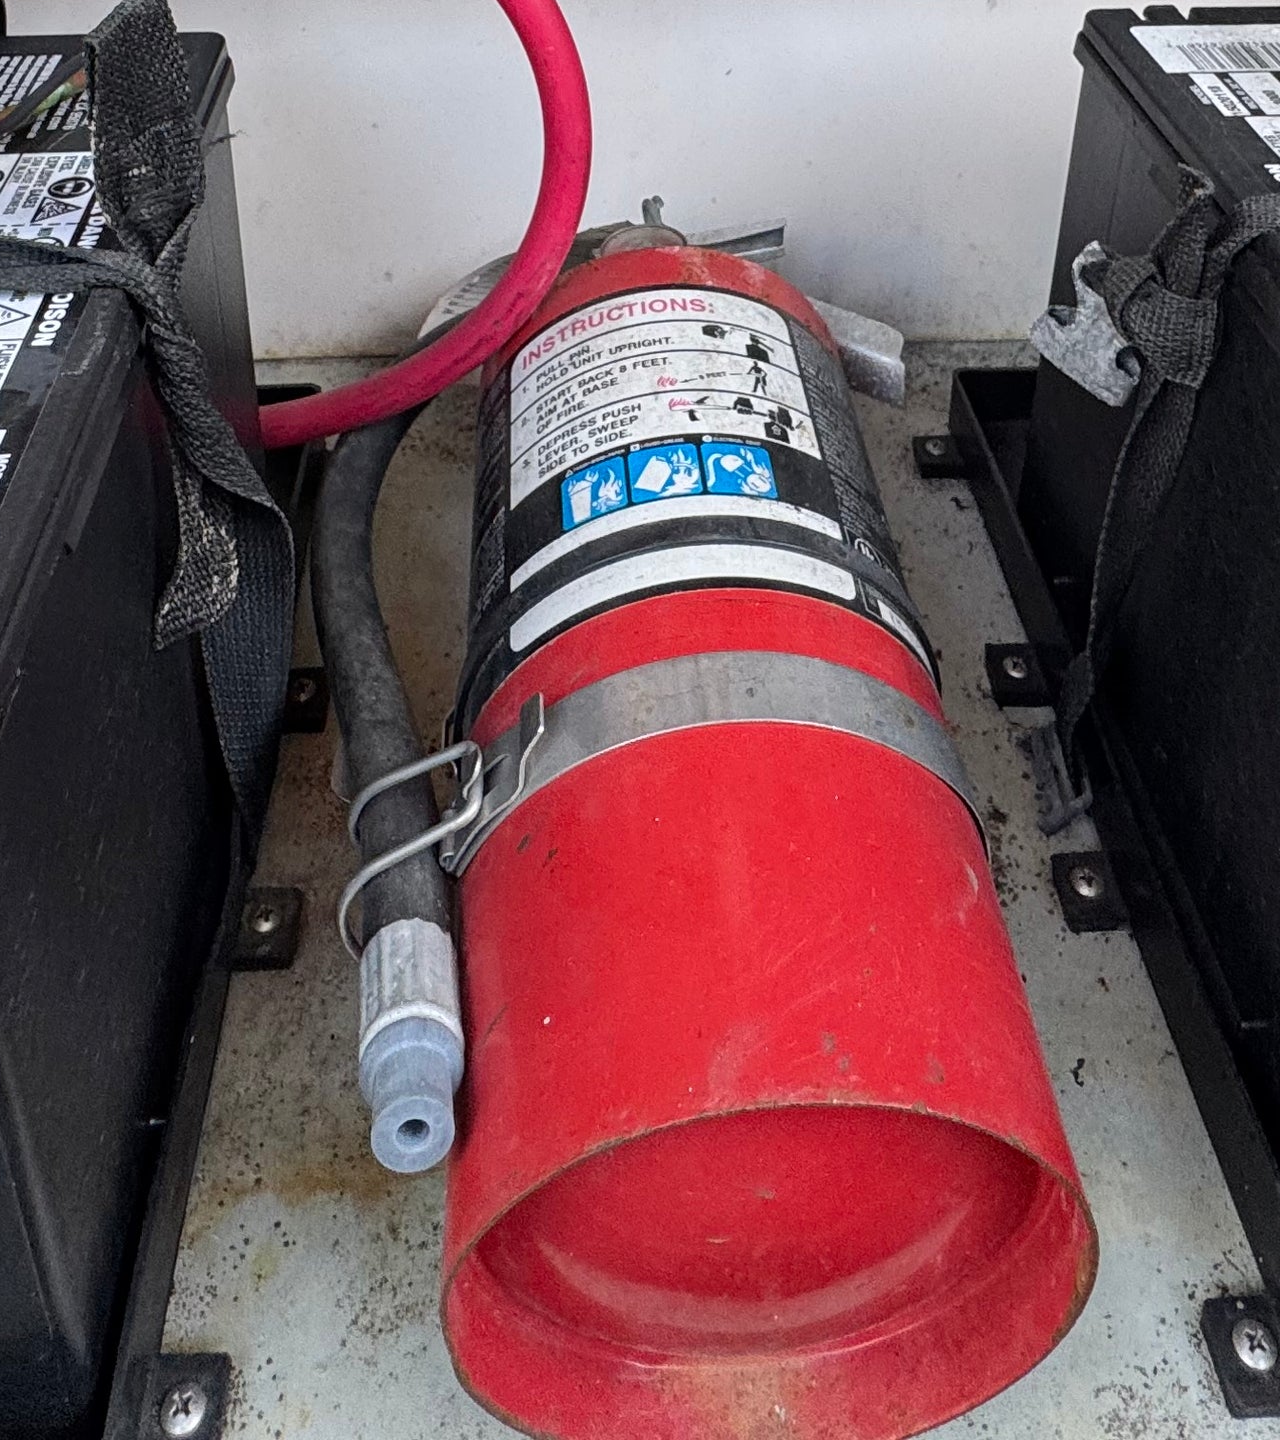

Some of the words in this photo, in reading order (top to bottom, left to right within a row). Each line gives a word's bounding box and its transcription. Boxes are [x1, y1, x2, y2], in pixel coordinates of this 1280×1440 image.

[522, 298, 715, 370] INSTRUCTIONS:
[536, 367, 569, 393] HOLD
[571, 351, 603, 369] UNIT
[609, 337, 675, 355] UPRIGHT.
[536, 360, 564, 382] PULL
[536, 387, 572, 414] START
[578, 367, 614, 388] BACK
[619, 364, 627, 373] 8
[632, 357, 672, 371] FEET.
[536, 407, 557, 424] AIM
[562, 395, 576, 408] AT
[582, 377, 619, 397] BASE
[536, 421, 552, 435] OF
[538, 417, 597, 456] DEPRESS
[602, 403, 641, 421] PUSH
[538, 438, 583, 467] LEVER.
[588, 415, 639, 438] SWEEP
[538, 457, 567, 479] SIDE
[573, 444, 589, 457] TO
[595, 429, 633, 447] SIDE.
